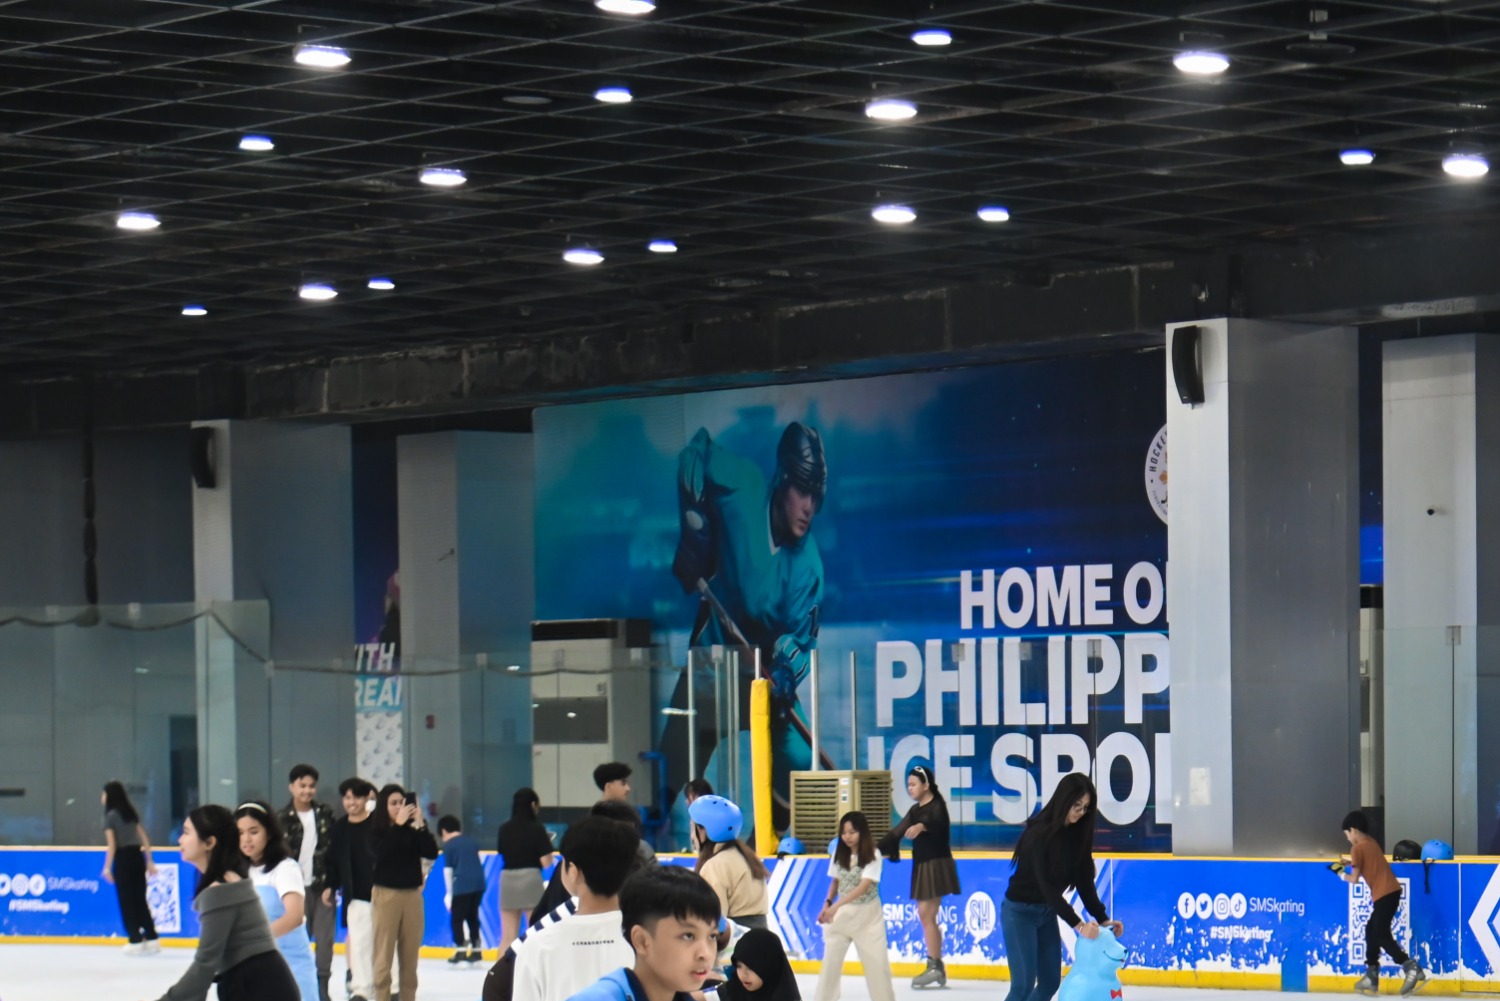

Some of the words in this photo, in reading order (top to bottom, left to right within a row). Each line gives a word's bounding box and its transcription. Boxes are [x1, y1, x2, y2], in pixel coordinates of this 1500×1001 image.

[960, 563, 1114, 629] HOME
[1123, 561, 1170, 625] O
[354, 642, 396, 672] ITH
[990, 732, 1173, 826] SPO
[1249, 897, 1305, 916] SMSkating
